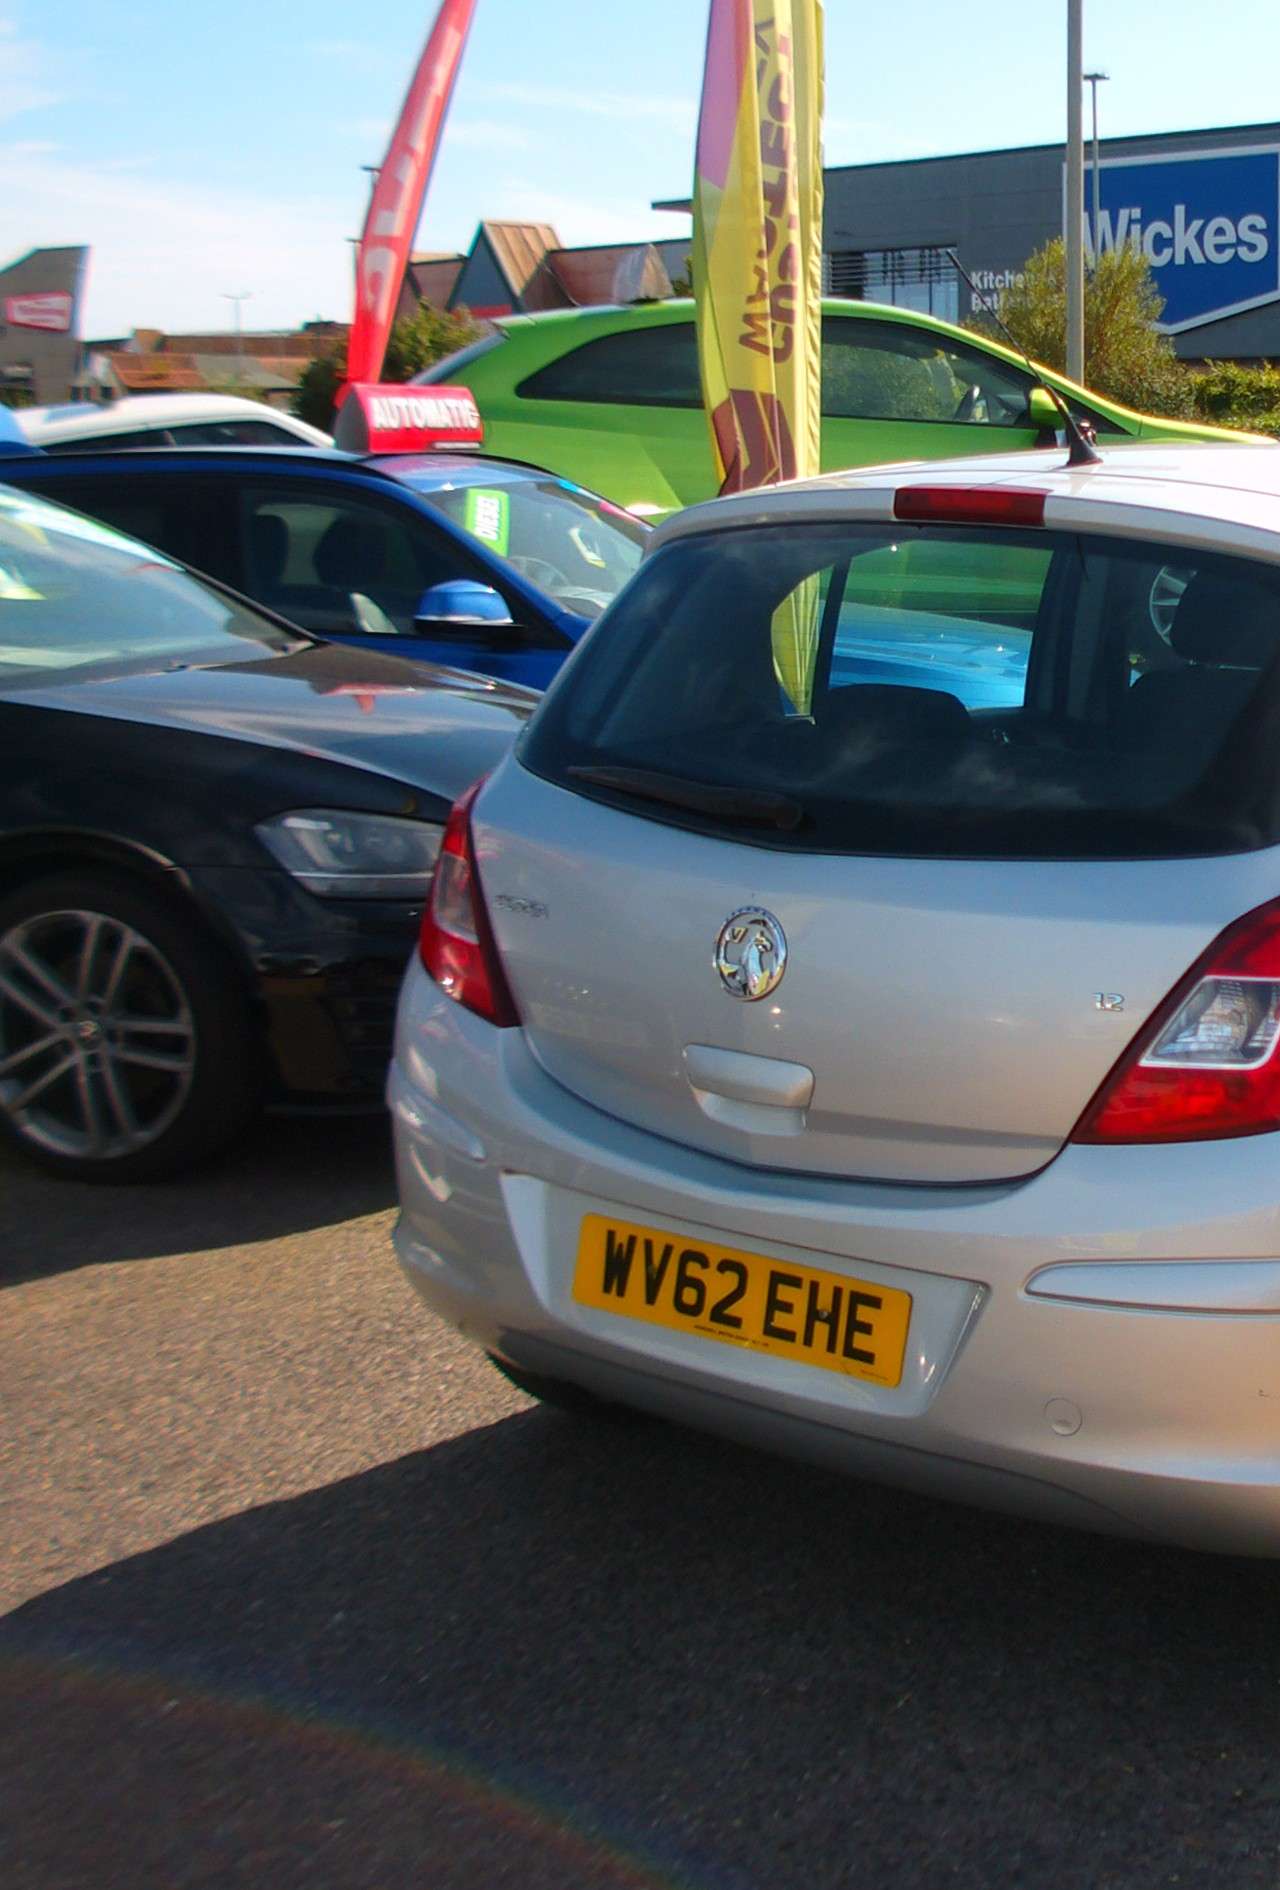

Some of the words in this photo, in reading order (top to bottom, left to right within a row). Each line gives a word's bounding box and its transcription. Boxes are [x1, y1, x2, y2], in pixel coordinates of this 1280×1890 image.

[1083, 204, 1269, 268] Wickes
[371, 396, 480, 429] AUTOMATIC
[602, 1229, 749, 1330] WV62
[762, 1269, 883, 1366] EHE
